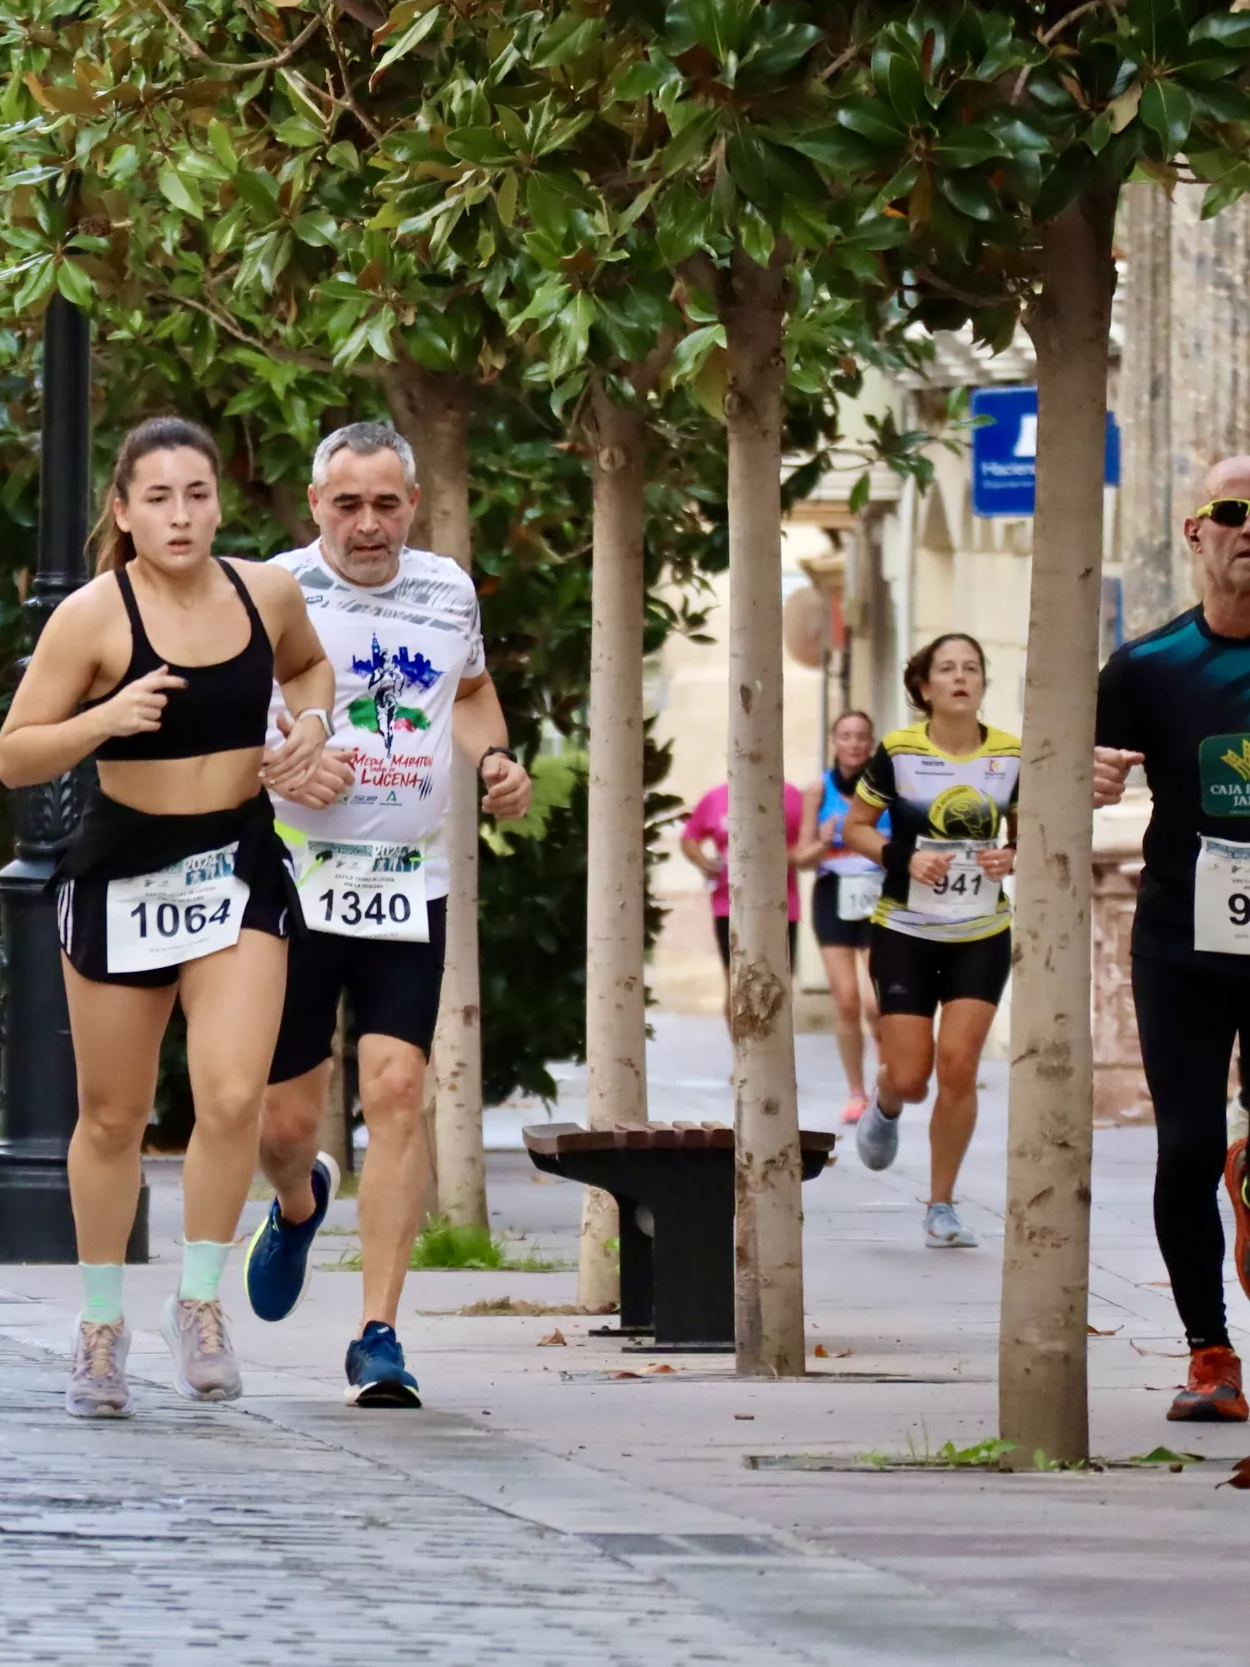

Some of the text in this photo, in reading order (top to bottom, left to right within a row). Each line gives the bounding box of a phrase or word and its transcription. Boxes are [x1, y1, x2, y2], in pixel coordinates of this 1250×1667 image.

[980, 461, 1036, 476] Hacien
[360, 768, 419, 788] LUCENA
[1210, 783, 1244, 796] CAJA
[372, 844, 403, 859] 2024
[319, 888, 412, 925] 1340
[130, 898, 231, 938] 1064
